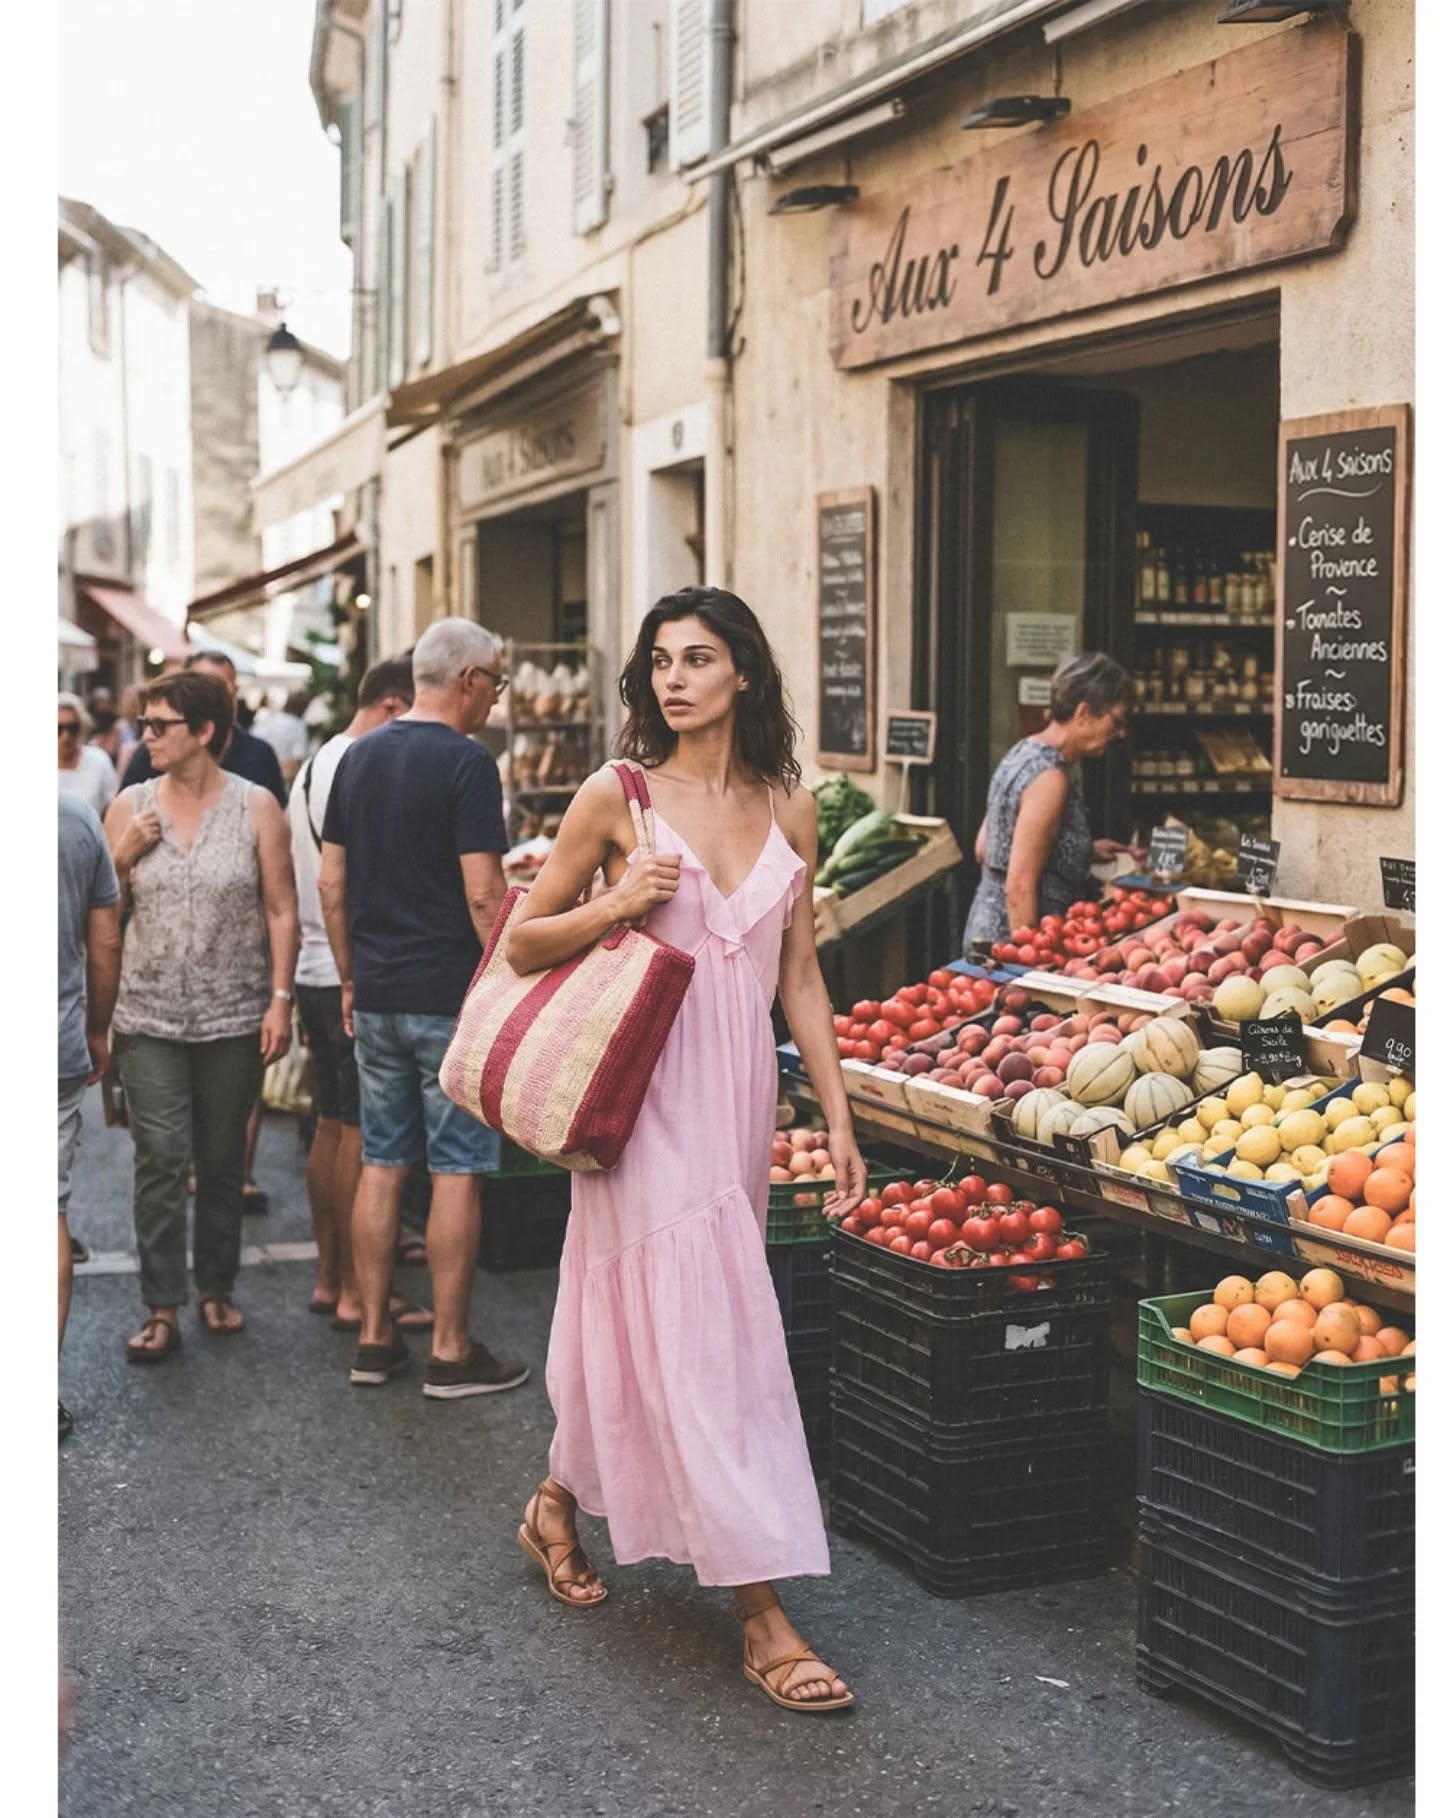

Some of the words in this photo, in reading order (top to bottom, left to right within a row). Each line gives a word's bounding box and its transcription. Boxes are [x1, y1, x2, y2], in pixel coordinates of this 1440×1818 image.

[851, 205, 959, 333] Aux
[976, 175, 1015, 295] 4
[1034, 124, 1293, 280] Saisons
[1289, 451, 1318, 483] Aux
[1321, 447, 1332, 482] 4
[1336, 446, 1393, 478] Saisons
[1298, 516, 1346, 548] Cerise
[1351, 516, 1375, 544] de
[1311, 549, 1379, 579] Provence
[1296, 600, 1362, 630] Tomates
[1310, 633, 1388, 662] Anciennes
[1296, 679, 1354, 712] Fraises
[1299, 712, 1386, 755] gariguettes
